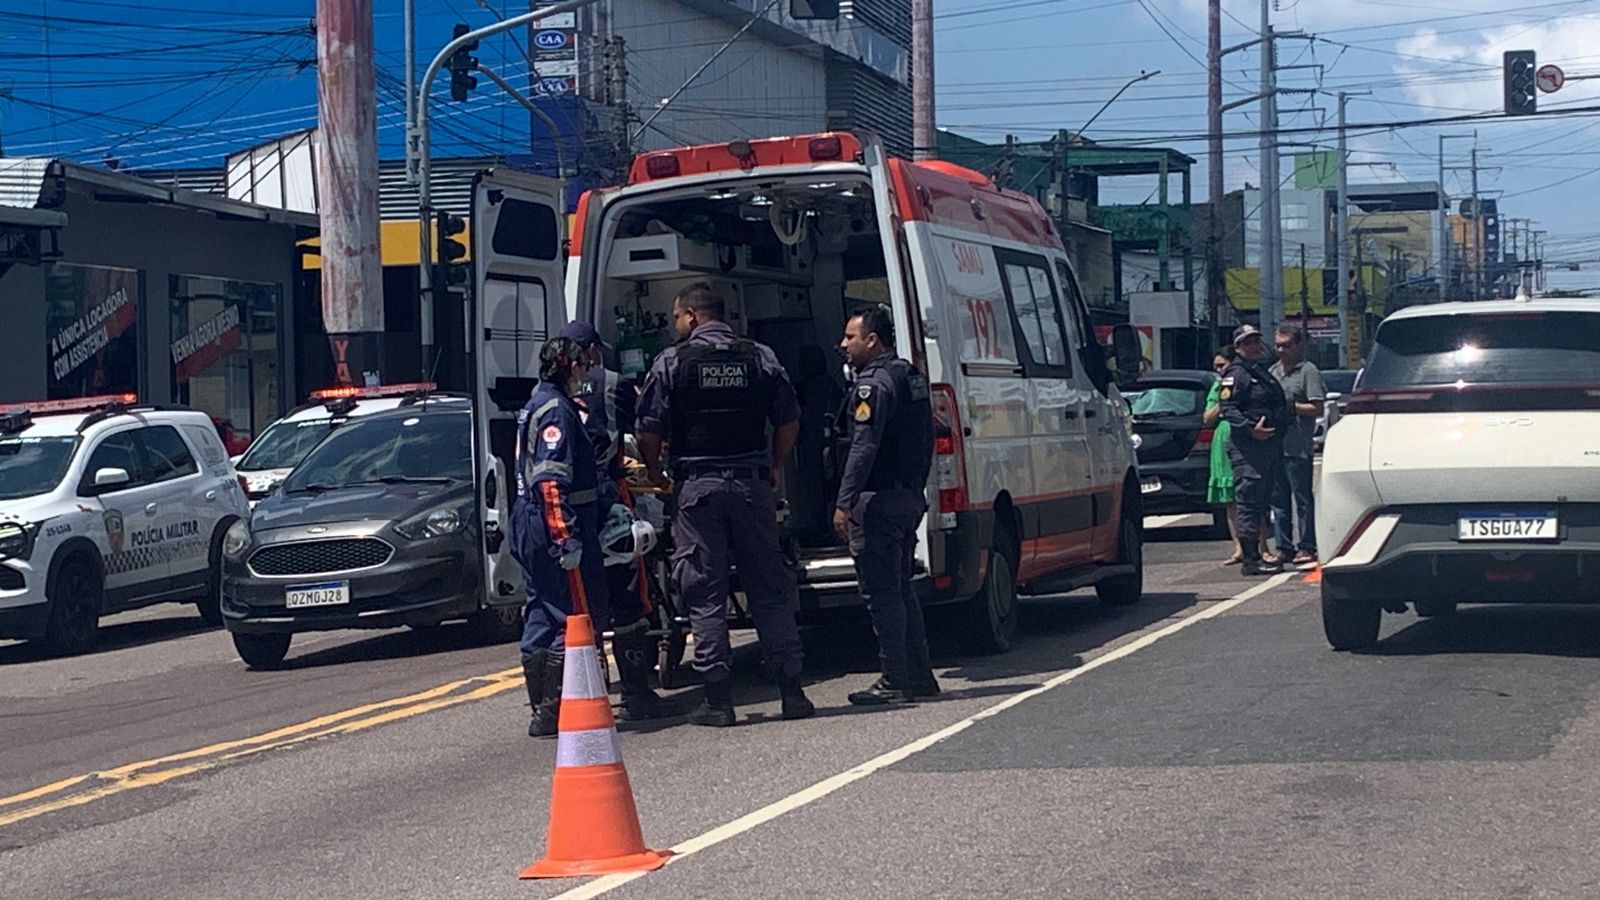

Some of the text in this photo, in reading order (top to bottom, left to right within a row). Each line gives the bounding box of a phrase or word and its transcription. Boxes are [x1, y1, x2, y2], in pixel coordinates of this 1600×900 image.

[538, 36, 562, 44] CAA
[966, 299, 1003, 360] 192
[52, 337, 60, 357] A
[702, 364, 744, 377] POLÍCIA
[702, 377, 744, 387] MILITAR
[131, 519, 199, 547] POLÍCIA MILITAR
[1469, 520, 1545, 536] TSG0A77
